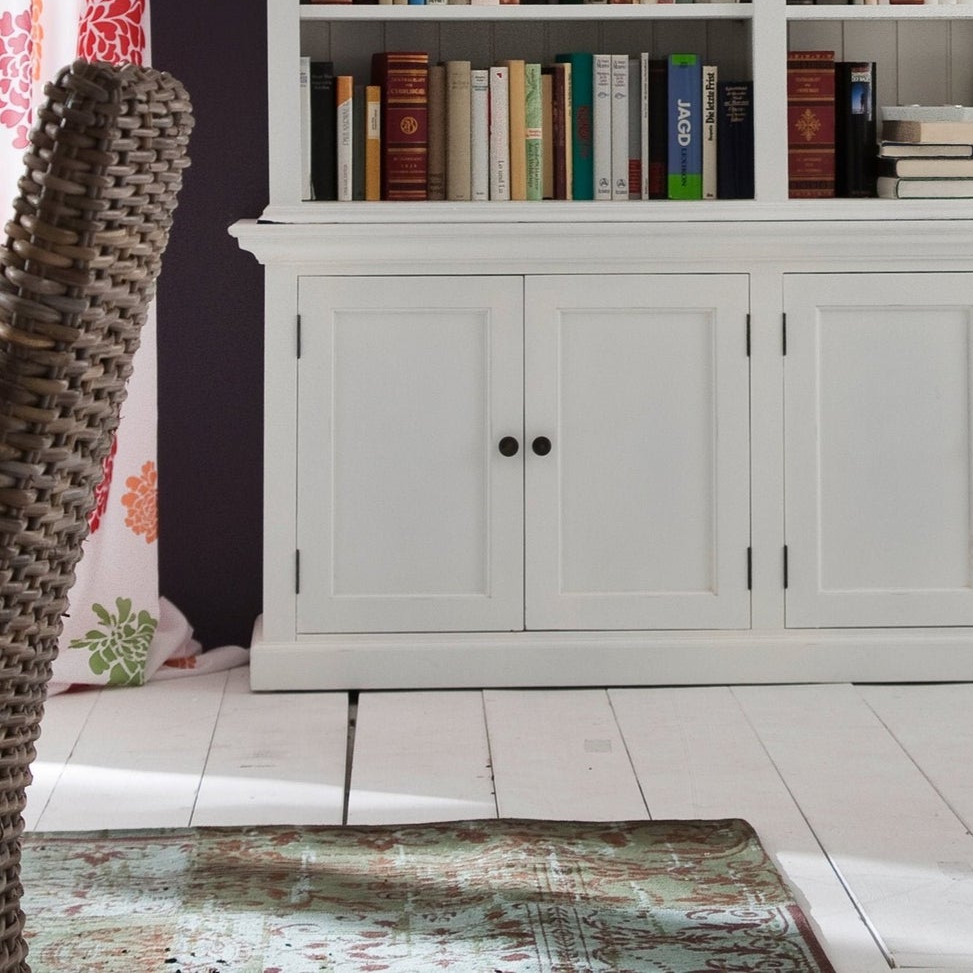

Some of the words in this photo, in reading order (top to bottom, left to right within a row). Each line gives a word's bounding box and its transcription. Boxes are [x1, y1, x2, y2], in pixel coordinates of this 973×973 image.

[706, 72, 714, 90] Frist
[706, 91, 714, 110] letzte
[678, 99, 691, 147] JAGD
[706, 112, 714, 124] Die
